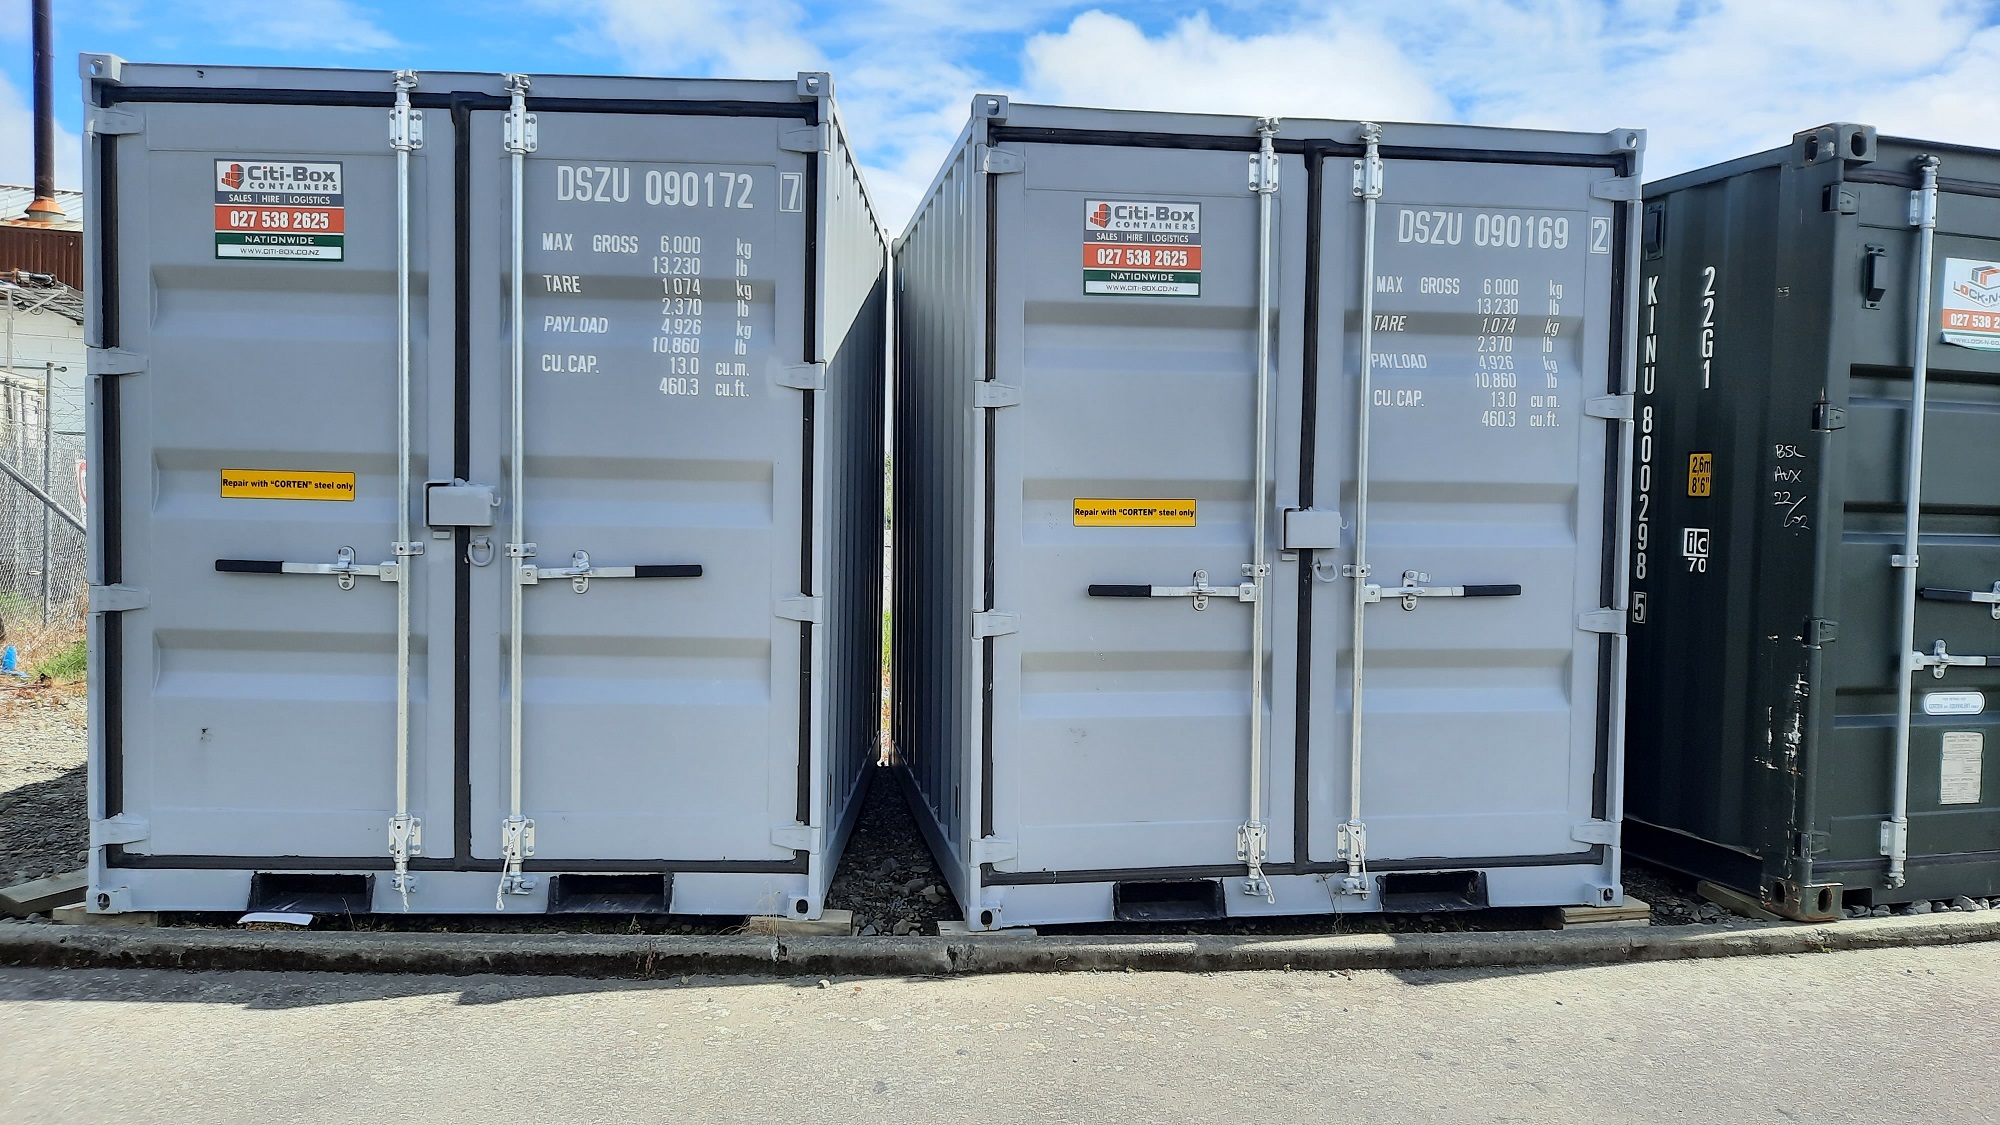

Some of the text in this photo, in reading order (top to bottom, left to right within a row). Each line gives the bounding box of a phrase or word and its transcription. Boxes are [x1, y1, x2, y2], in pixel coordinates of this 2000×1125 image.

[248, 165, 336, 183] Citi-Box
[249, 183, 337, 191] CONTAINERS
[557, 165, 800, 210] DSZU 090172 7
[228, 193, 330, 205] SALES HIRE LOGISTICS
[230, 211, 329, 229] 027 538 2625
[1115, 205, 1195, 222] Citi-Box
[1116, 221, 1196, 230] CONTAINERS
[1398, 209, 1608, 252] DSZU 090169 2
[245, 235, 315, 245] NATIONWIDE
[542, 232, 573, 251] MAX
[592, 234, 639, 254] GROSS
[736, 237, 752, 260] kg
[1096, 233, 1118, 241] SALES
[1152, 234, 1189, 243] LOGISTICS
[1097, 248, 1187, 266] 027 538 2625
[736, 258, 748, 277] lb
[1110, 272, 1174, 281] NATIONWIDE
[542, 274, 582, 293] TARE
[736, 279, 752, 300] kg
[1376, 275, 1403, 293] MAX
[1420, 277, 1460, 295] GROSS
[1549, 279, 1563, 300] kg
[737, 299, 749, 317] lb
[1549, 299, 1559, 316] lb
[543, 315, 609, 334] PAYLOAD
[736, 320, 752, 339] kg
[1374, 315, 1407, 332] TARE
[1544, 318, 1560, 337] kg
[1701, 266, 1716, 390] 22G1
[1950, 313, 1969, 327] 027
[1972, 314, 1992, 328] 538
[734, 338, 747, 355] lb
[1543, 336, 1553, 353] lb
[670, 356, 699, 375] 13.0
[715, 362, 750, 376] cu.m.
[1370, 353, 1428, 369] PAYLOAD
[1542, 355, 1558, 374] kg
[659, 377, 750, 397] 460.3 cu.ft.
[1546, 373, 1558, 389] lb
[1491, 391, 1517, 408] 13.0
[1481, 410, 1560, 427] 460.3 cu.ft.
[222, 478, 248, 488] Repair
[314, 481, 334, 489] steel
[336, 482, 353, 491] only
[1075, 508, 1099, 518] Repair
[1101, 508, 1117, 516] with
[1179, 509, 1194, 517] only
[1687, 557, 1706, 573] 70
[1634, 594, 1645, 621] 5
